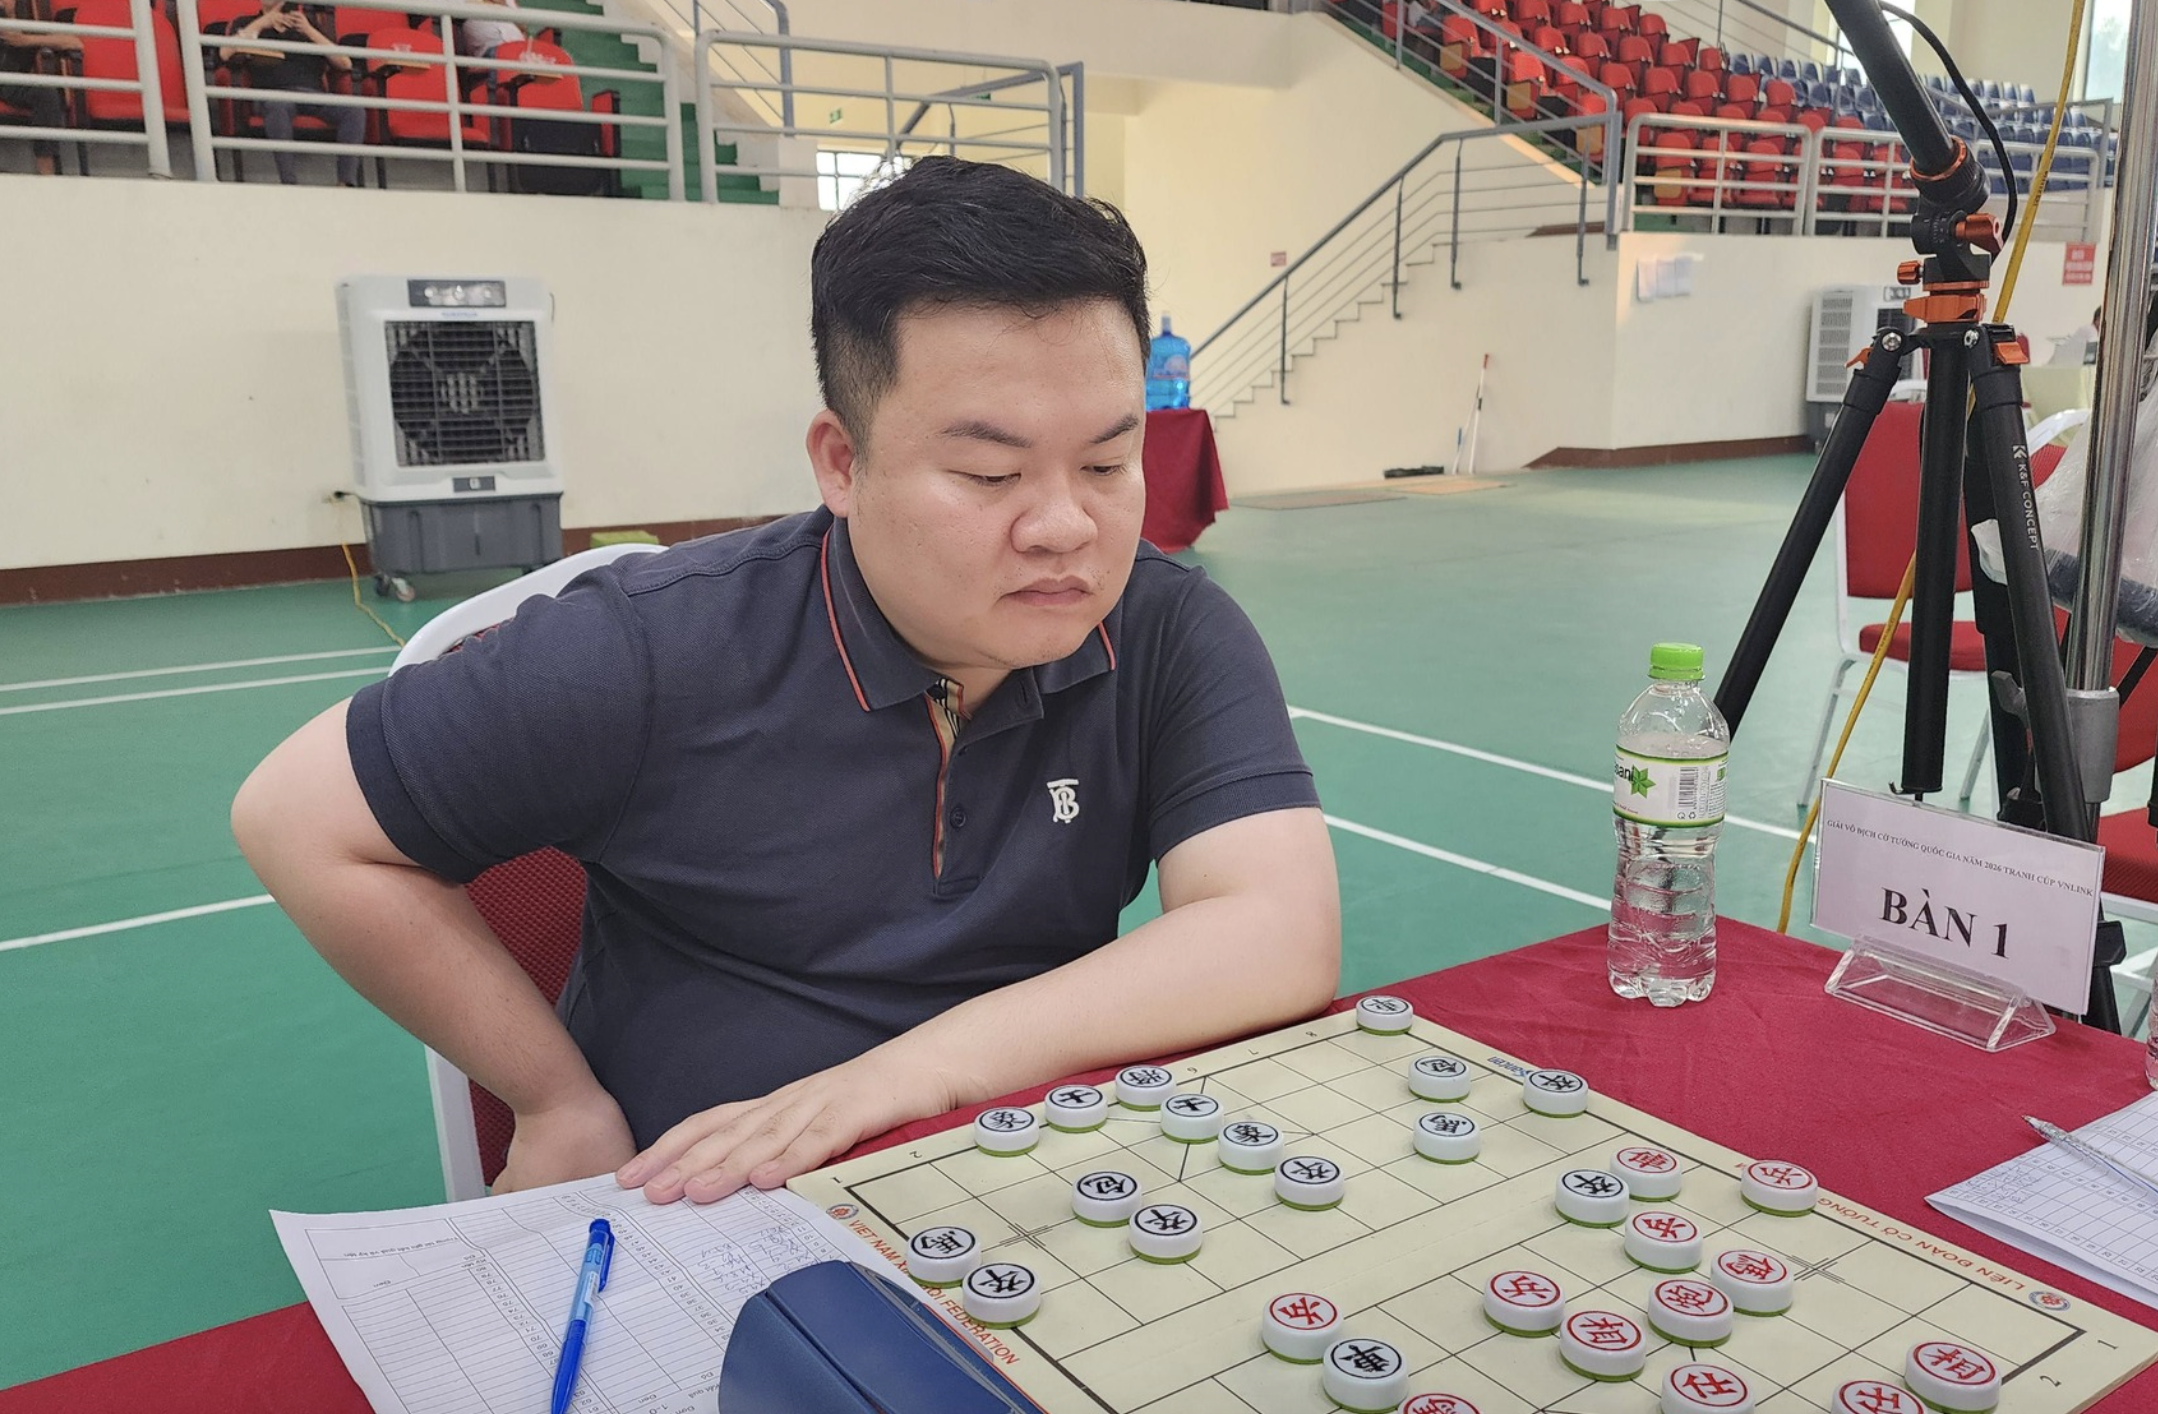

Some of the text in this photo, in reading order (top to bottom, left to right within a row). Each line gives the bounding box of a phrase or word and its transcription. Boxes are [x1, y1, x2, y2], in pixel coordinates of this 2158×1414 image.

[2017, 463, 2039, 551] K&F CONCEPT
[1920, 844, 1945, 857] QUỐC
[1946, 851, 1961, 861] GIA
[2003, 866, 2035, 881] TRANH
[2036, 875, 2056, 887] CÚP
[2057, 880, 2093, 897] VNLINK
[1879, 887, 2009, 960] BÀN 1
[1538, 1075, 1575, 1091] 卒
[1059, 1090, 1094, 1104] 士
[1174, 1098, 1210, 1112] 士
[1428, 1114, 1468, 1134] 馬
[1291, 1161, 1331, 1180] 卒
[1760, 1167, 1803, 1186] 兵
[1574, 1175, 1615, 1195] 卒
[1145, 1210, 1188, 1231] 卒
[1642, 1218, 1687, 1239] 兵
[920, 1230, 964, 1255] 馬
[1819, 1196, 2026, 1291] LIÊN ĐOÀN CỜ TƯỚNG
[849, 1219, 1020, 1366] VIET NAM FEDERATION
[978, 1270, 1025, 1294] 卒
[1502, 1275, 1552, 1299] 兵
[1278, 1297, 1324, 1326] 兵
[1580, 1318, 1629, 1344] 相
[1928, 1349, 1986, 1381] 相
[1682, 1372, 1738, 1399] 仕
